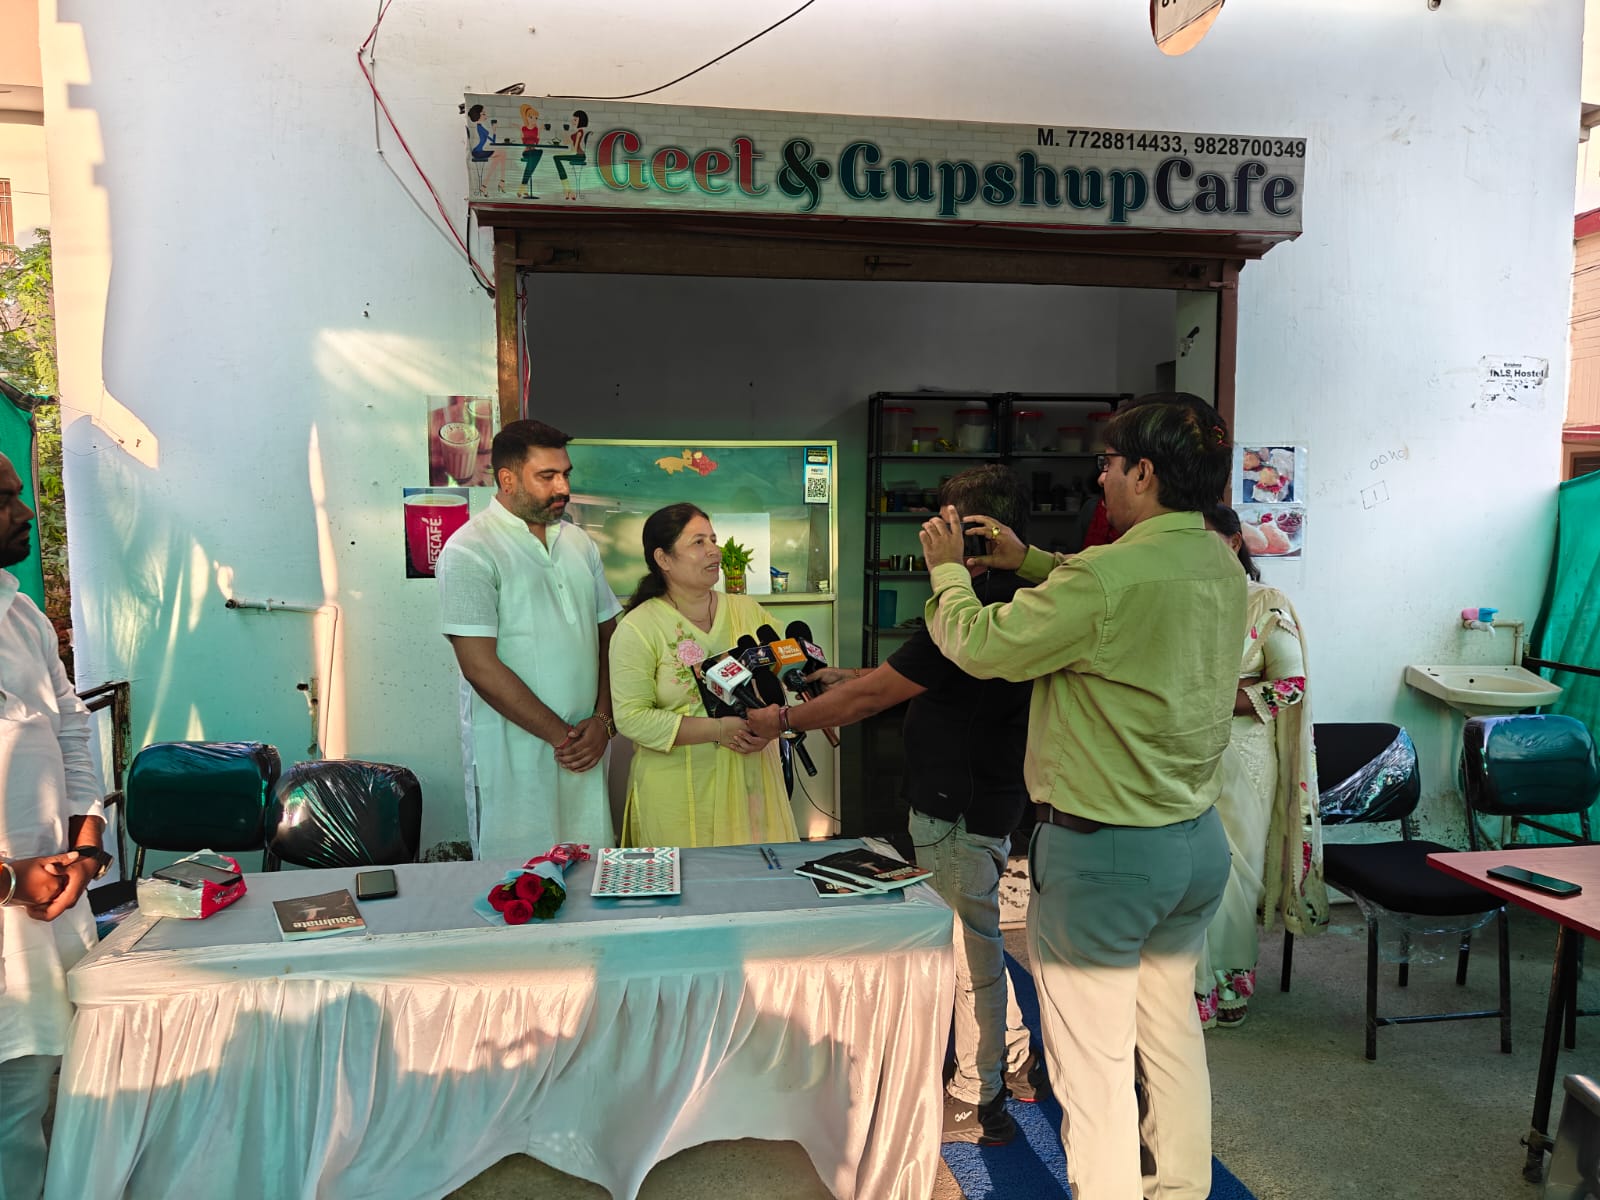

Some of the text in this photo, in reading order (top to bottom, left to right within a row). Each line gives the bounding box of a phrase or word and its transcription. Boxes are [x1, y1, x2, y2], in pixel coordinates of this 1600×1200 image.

[1037, 128, 1306, 159] M. 7728814433, 9828700349
[598, 129, 1297, 224] Geet & Gupshup Cafe
[292, 915, 357, 929] Soulmate
